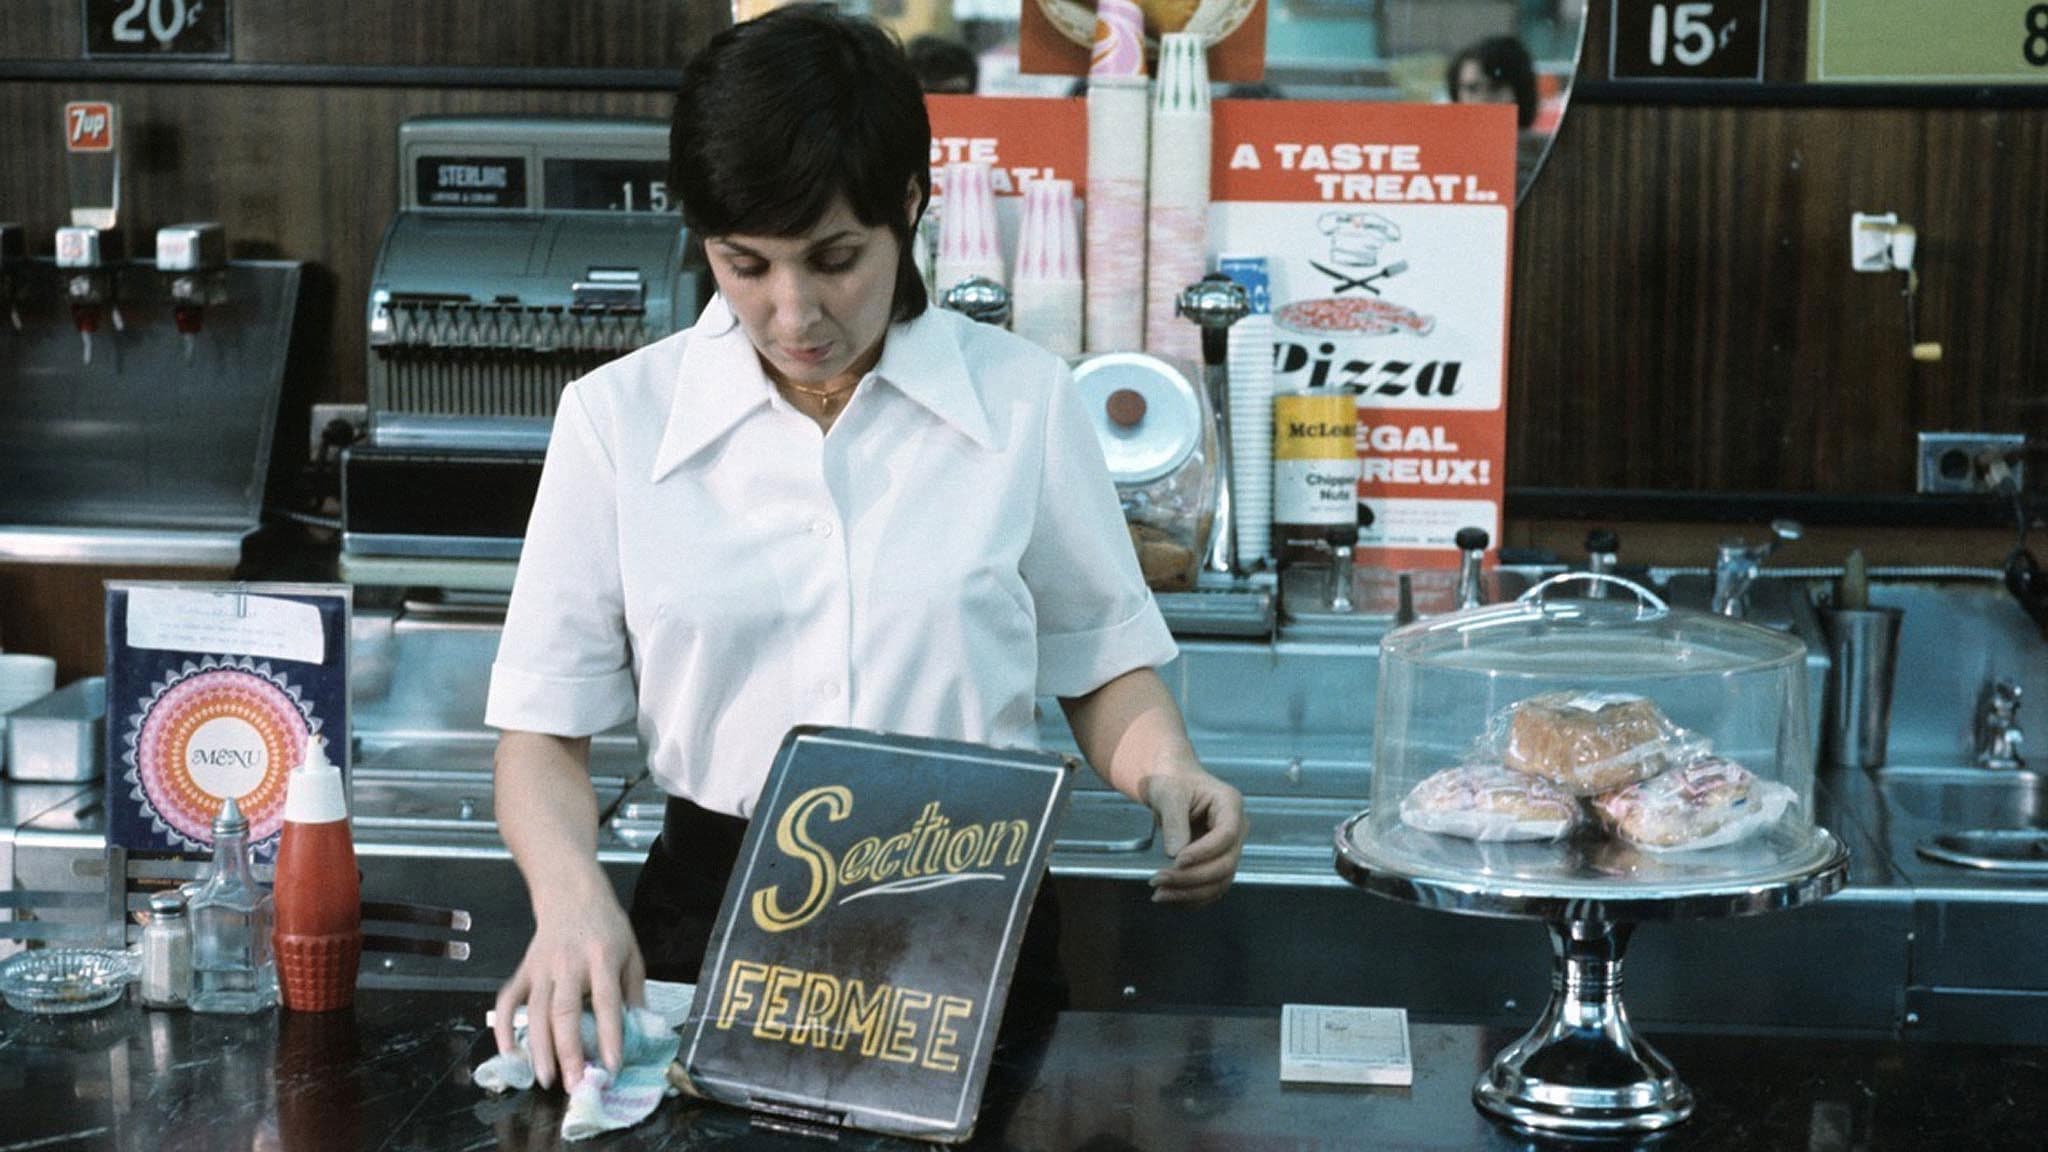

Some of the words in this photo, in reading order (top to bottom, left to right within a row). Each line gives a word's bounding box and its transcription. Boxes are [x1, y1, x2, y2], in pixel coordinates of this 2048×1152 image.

[1230, 144, 1261, 169] A
[1274, 144, 1421, 171] TASTE
[1273, 342, 1462, 396] Pizza
[1357, 457, 1491, 485] REUX!
[190, 748, 261, 769] MENU
[752, 785, 1030, 933] Section
[715, 959, 974, 1072] FERMEE
